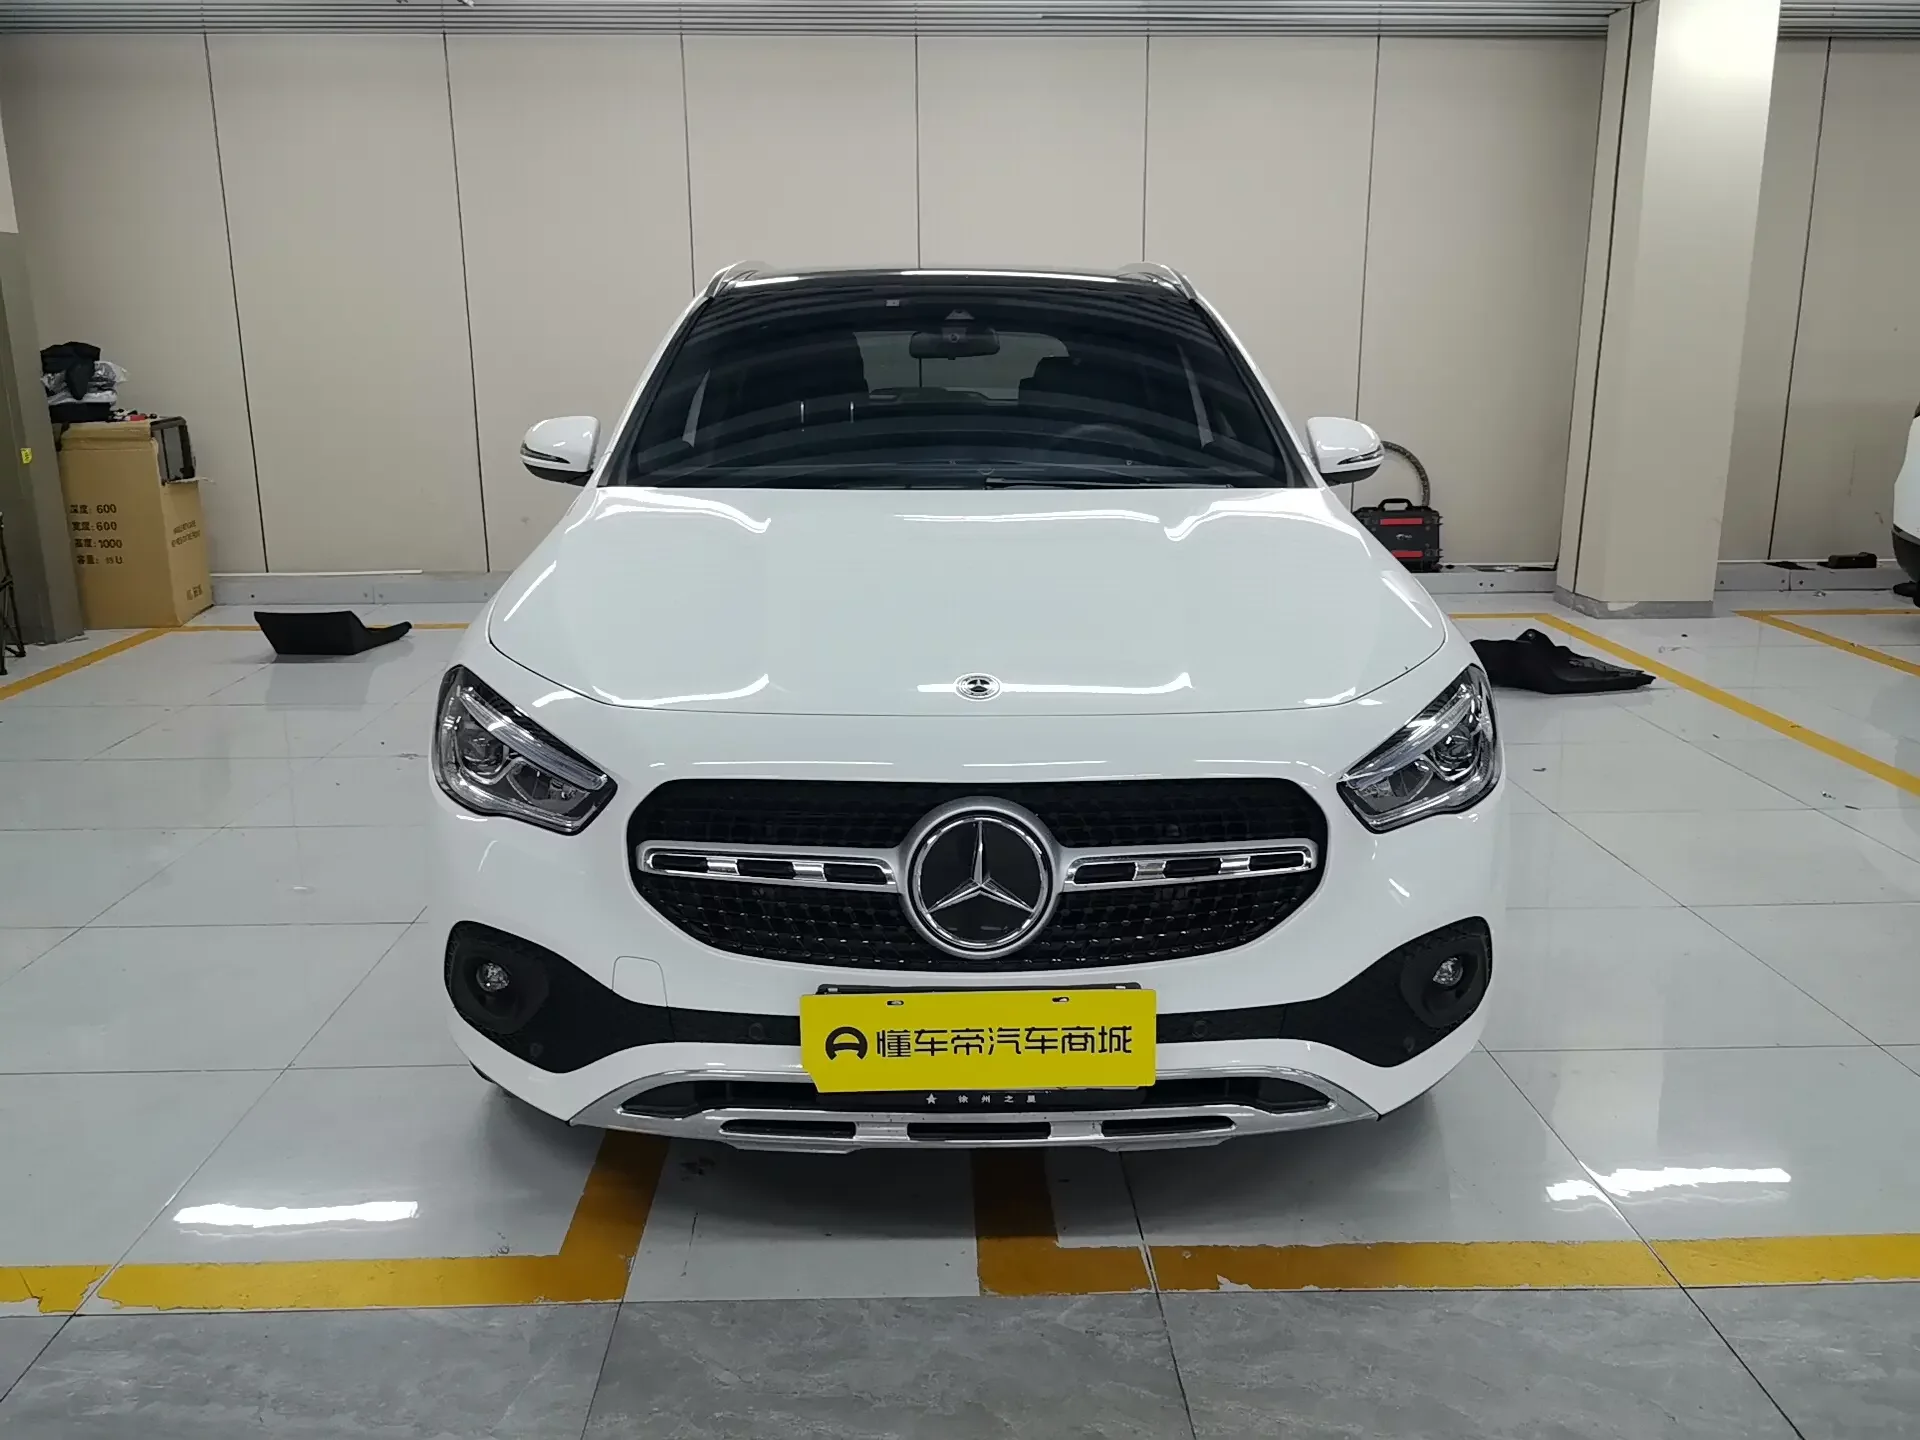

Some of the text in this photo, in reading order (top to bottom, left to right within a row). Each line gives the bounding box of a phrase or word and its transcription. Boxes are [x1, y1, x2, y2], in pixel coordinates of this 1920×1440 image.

[876, 1026, 1132, 1058] 懂车帝汽车商城
